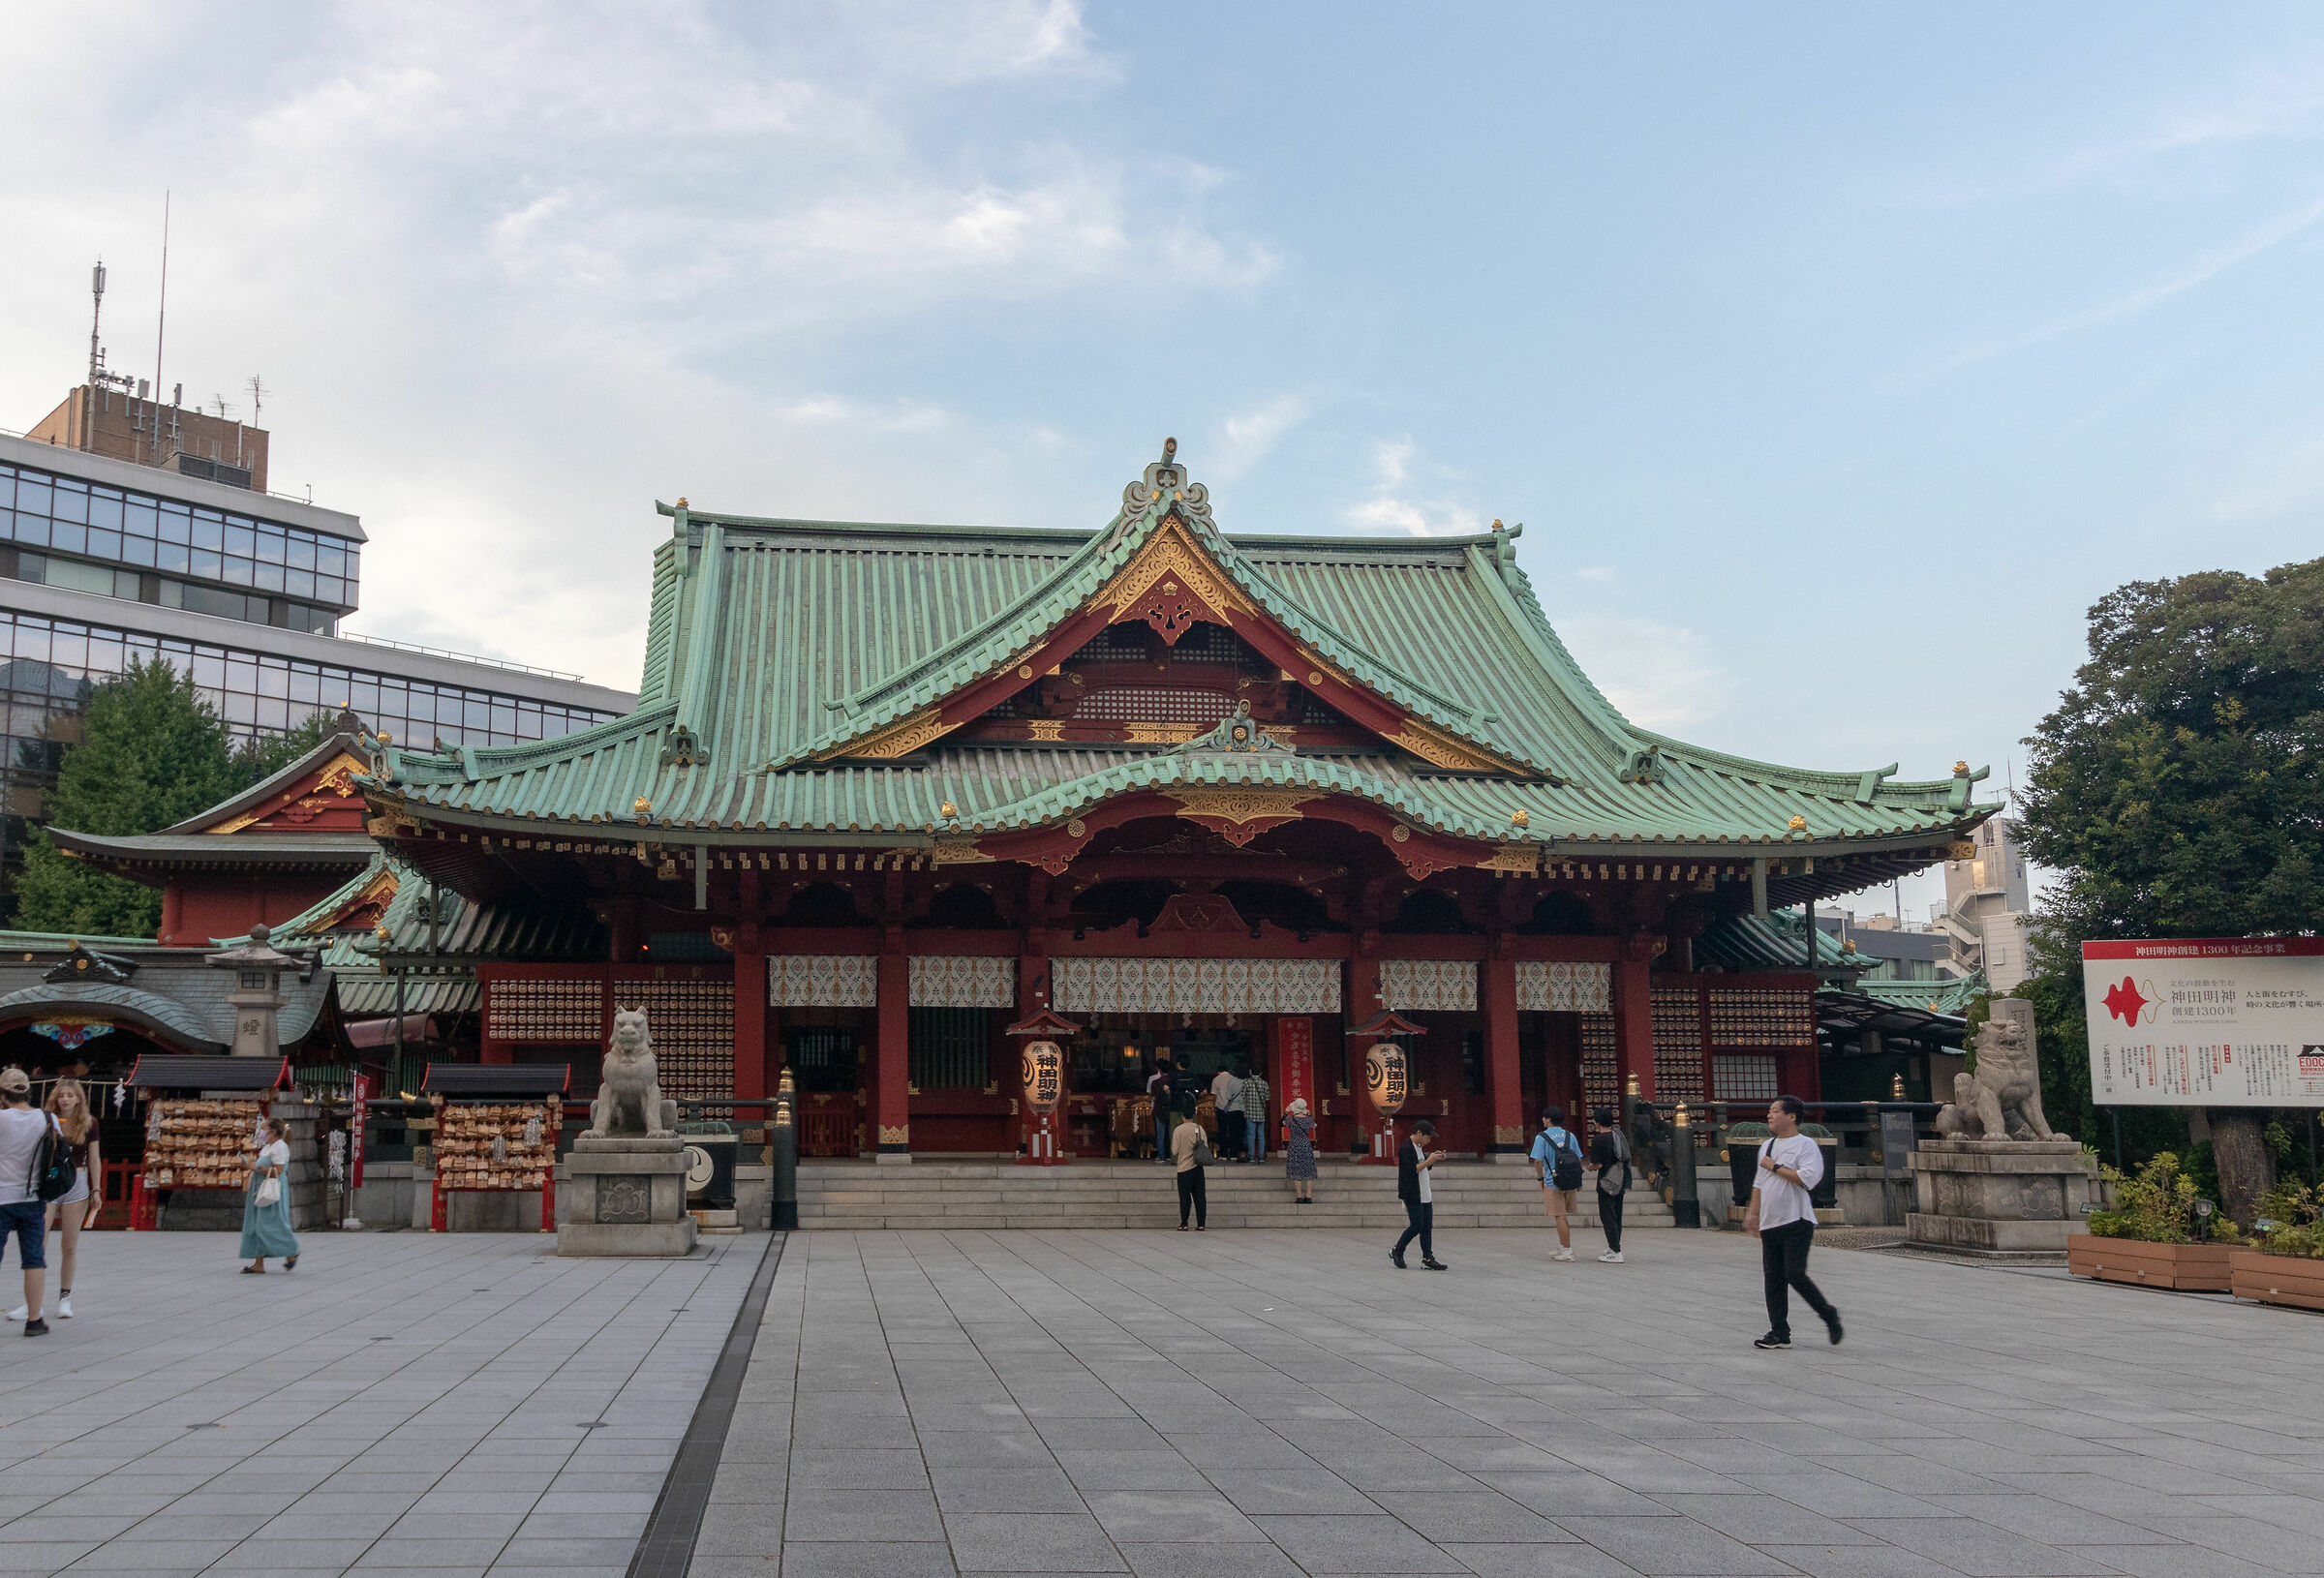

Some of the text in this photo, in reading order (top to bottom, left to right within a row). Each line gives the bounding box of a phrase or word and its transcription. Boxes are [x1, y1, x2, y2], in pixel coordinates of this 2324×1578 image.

[2171, 990, 2236, 1003] 神田明神
[2246, 1000, 2324, 1009] 時の文化が響く場所
[2172, 1006, 2238, 1017] 創建1300年
[1036, 1054, 1058, 1102] 神田明神
[1385, 1056, 1405, 1103] 神田明神
